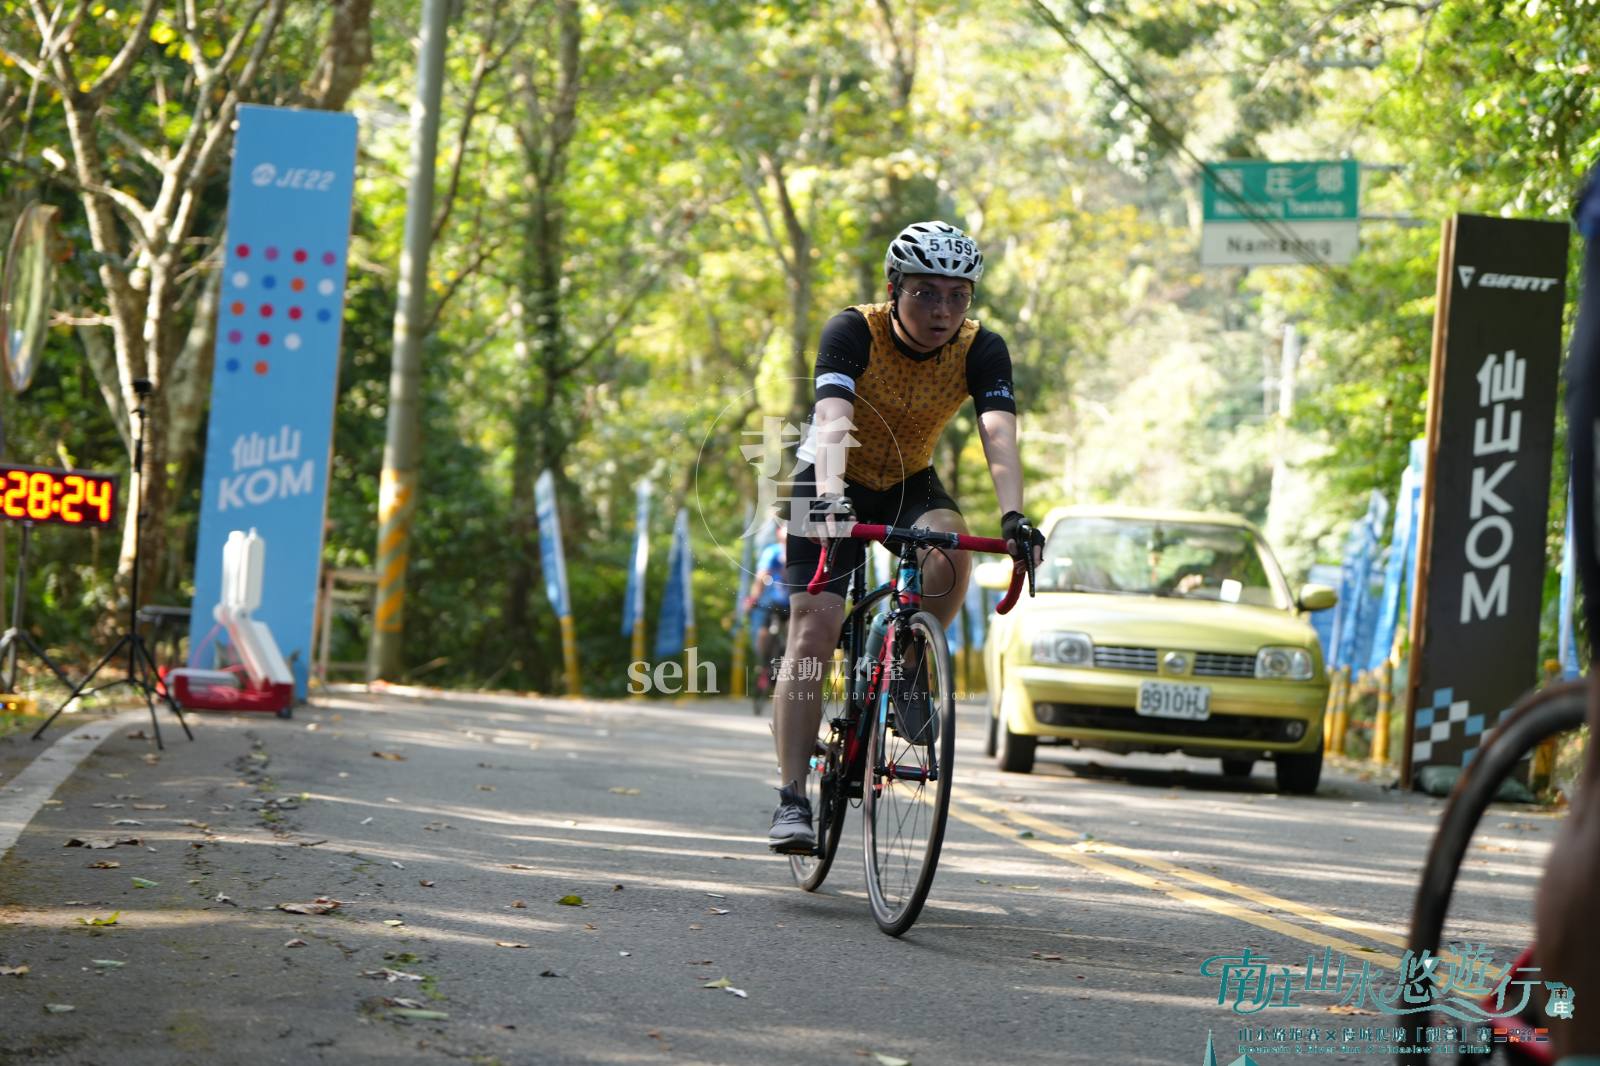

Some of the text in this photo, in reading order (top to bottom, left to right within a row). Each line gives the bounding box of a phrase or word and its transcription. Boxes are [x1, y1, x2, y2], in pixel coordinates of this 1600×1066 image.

[276, 168, 336, 192] JE22
[1478, 273, 1559, 292] GIANT
[231, 425, 302, 472] 仙山
[218, 459, 315, 512] KOM
[1460, 460, 1517, 624] KOM
